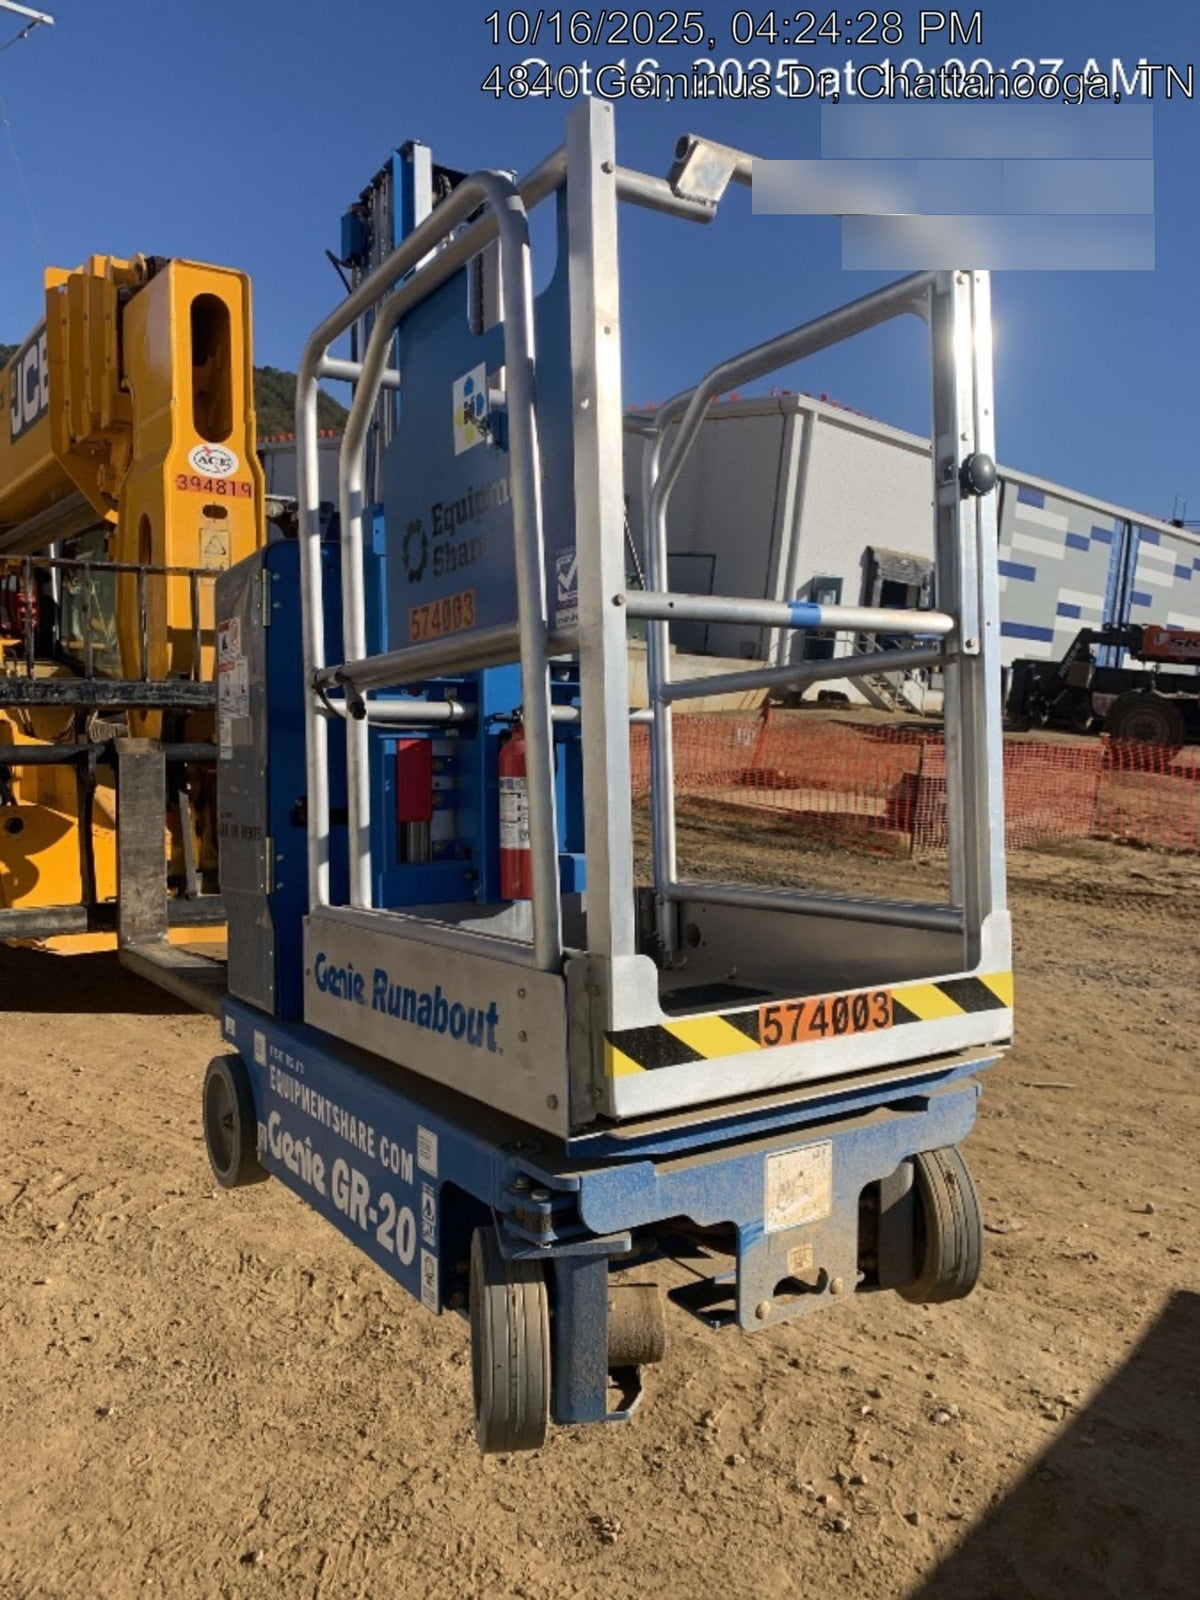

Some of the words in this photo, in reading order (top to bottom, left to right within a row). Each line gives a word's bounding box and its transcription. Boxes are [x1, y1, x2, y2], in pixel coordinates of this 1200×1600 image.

[176, 474, 252, 498] 394819
[411, 592, 474, 640] 574003
[314, 952, 366, 1005] Genie
[372, 966, 500, 1053] Runabout
[763, 991, 891, 1047] 574003
[268, 1110, 326, 1196] Genie
[332, 1158, 417, 1267] GR-20
